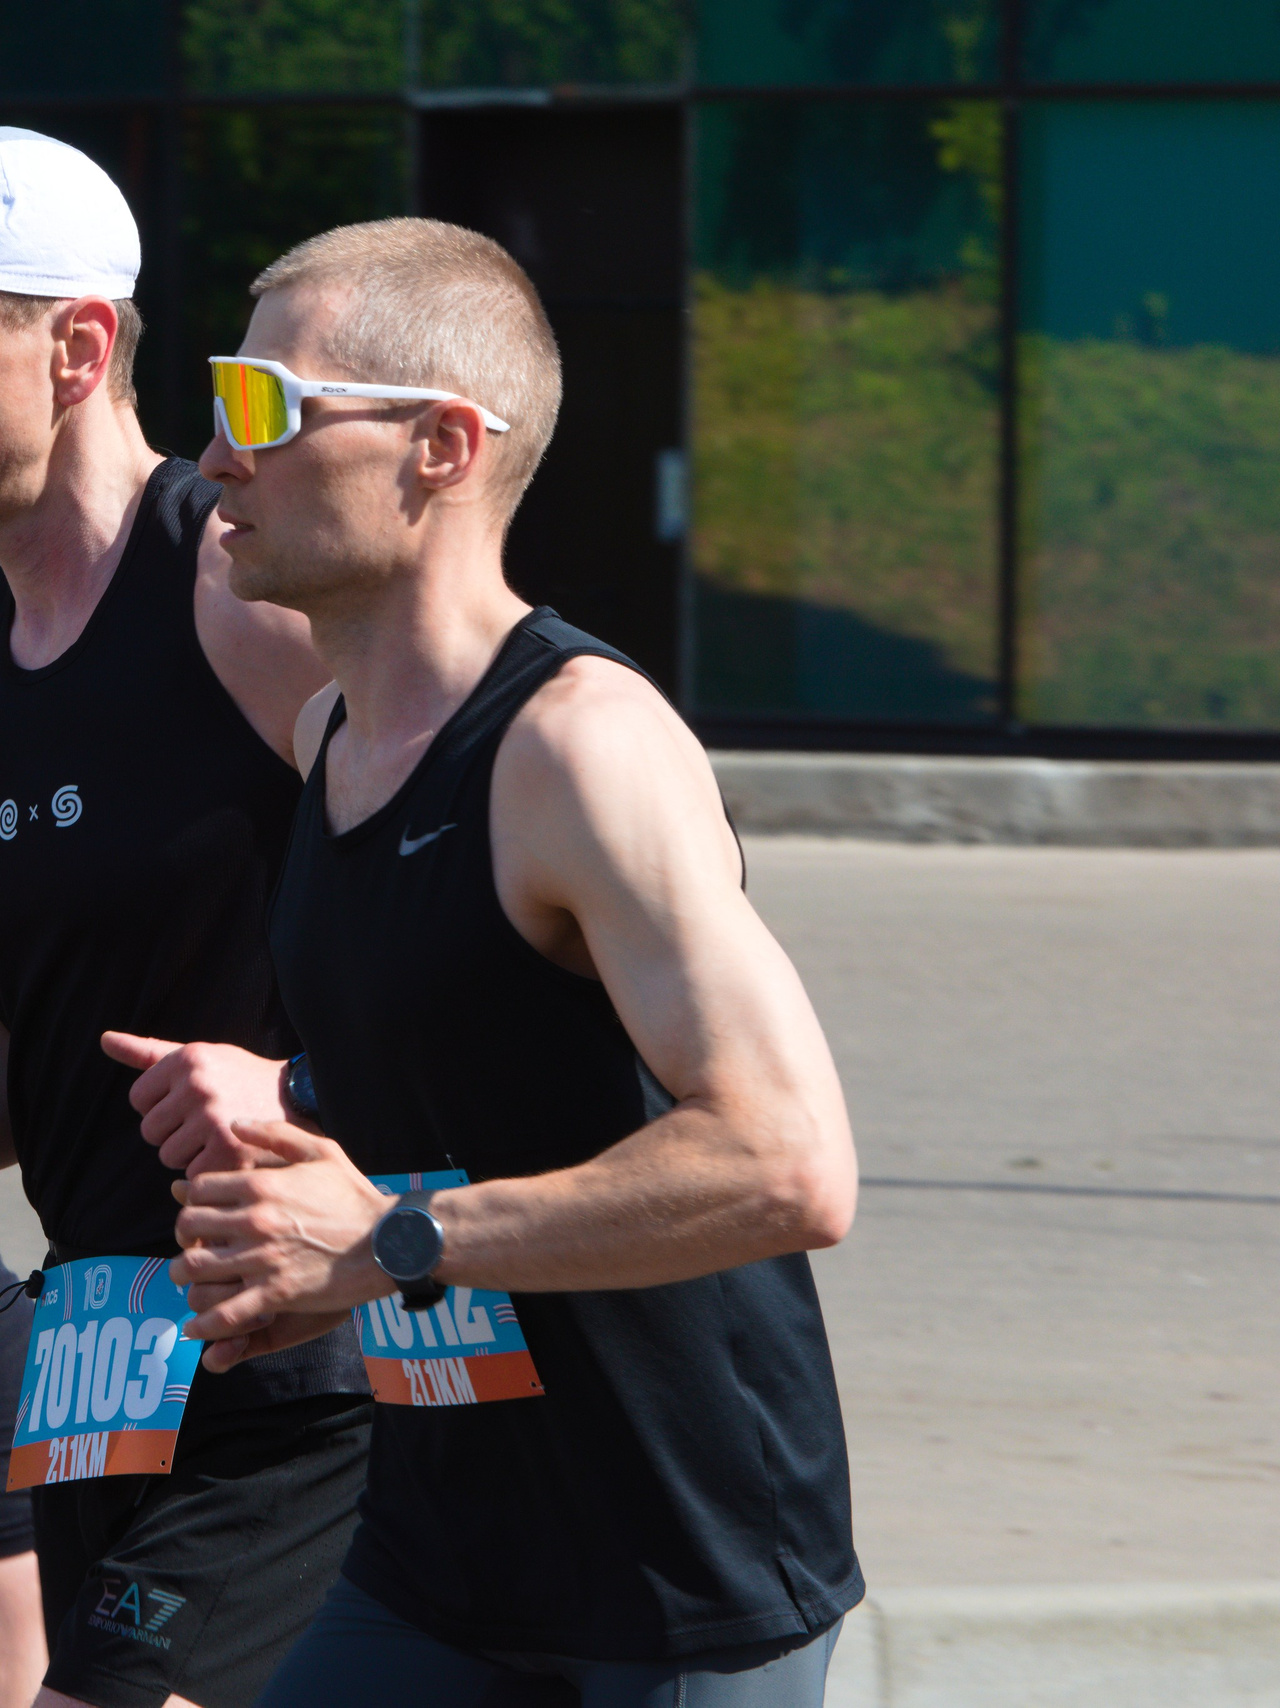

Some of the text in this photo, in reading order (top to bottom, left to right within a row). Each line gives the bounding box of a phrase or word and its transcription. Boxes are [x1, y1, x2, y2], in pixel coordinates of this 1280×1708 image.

[83, 1264, 113, 1311] 10
[28, 1316, 178, 1433] 70103
[45, 1430, 110, 1485] 21.1KM
